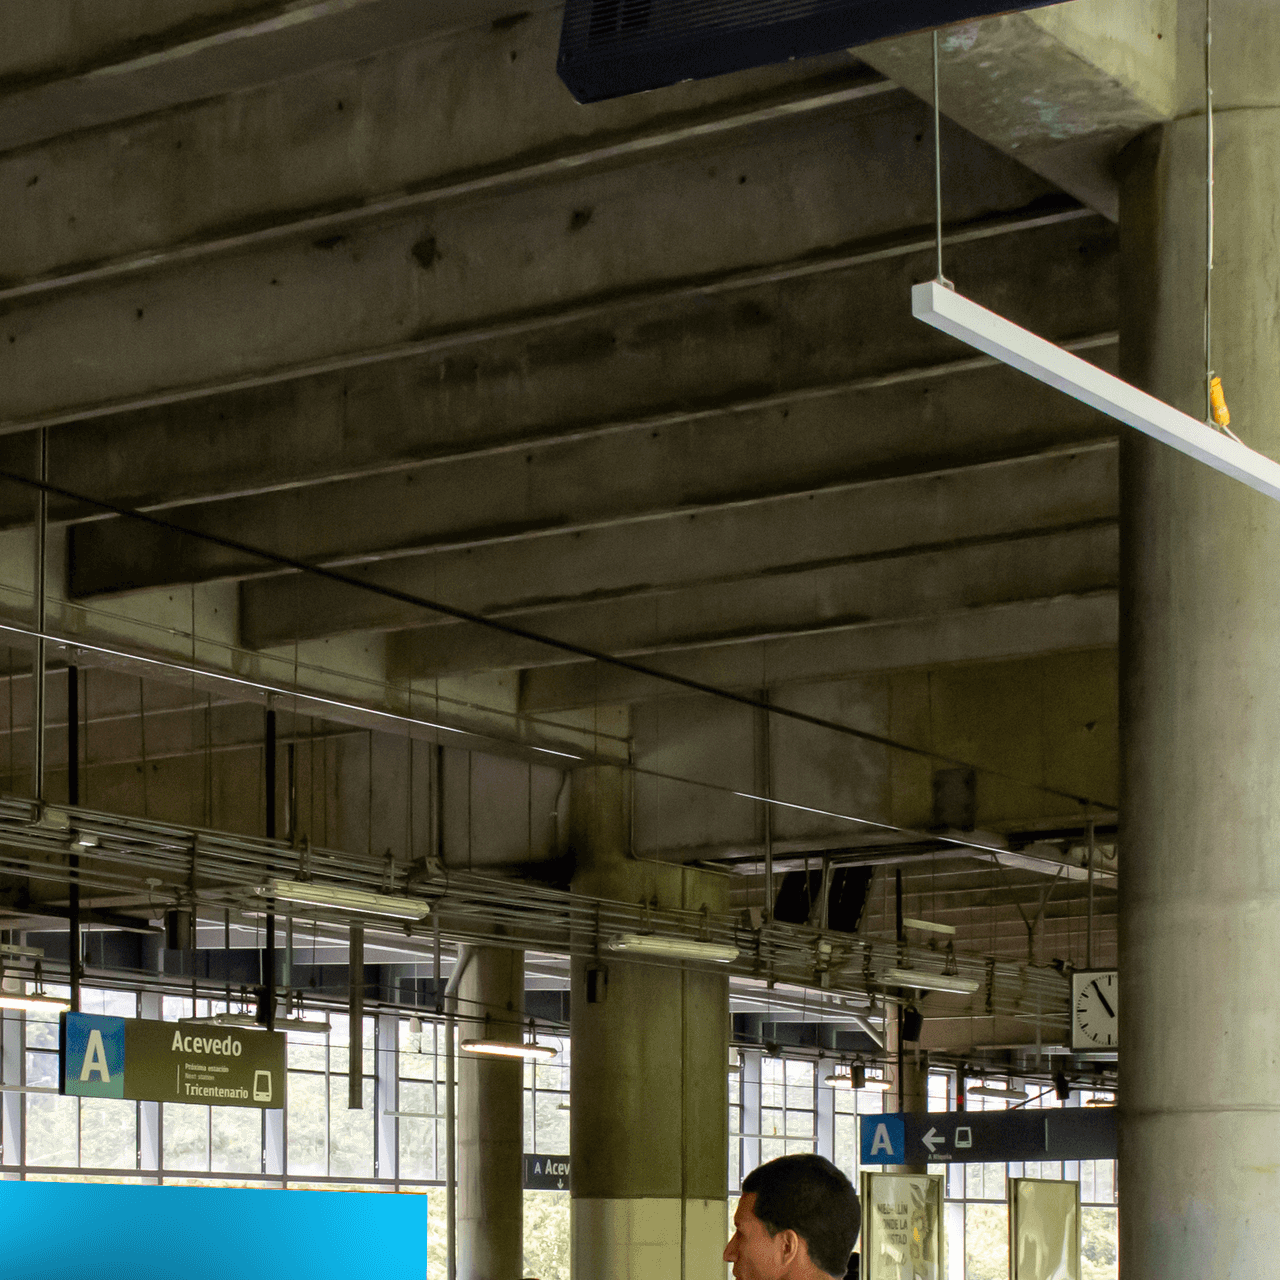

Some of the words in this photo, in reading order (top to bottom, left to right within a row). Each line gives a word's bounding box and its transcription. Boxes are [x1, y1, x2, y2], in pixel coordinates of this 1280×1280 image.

[80, 1029, 111, 1083] A
[171, 1030, 243, 1057] Acevedo
[184, 1082, 249, 1099] Tricentenario
[870, 1123, 894, 1155] A
[534, 1161, 542, 1174] A
